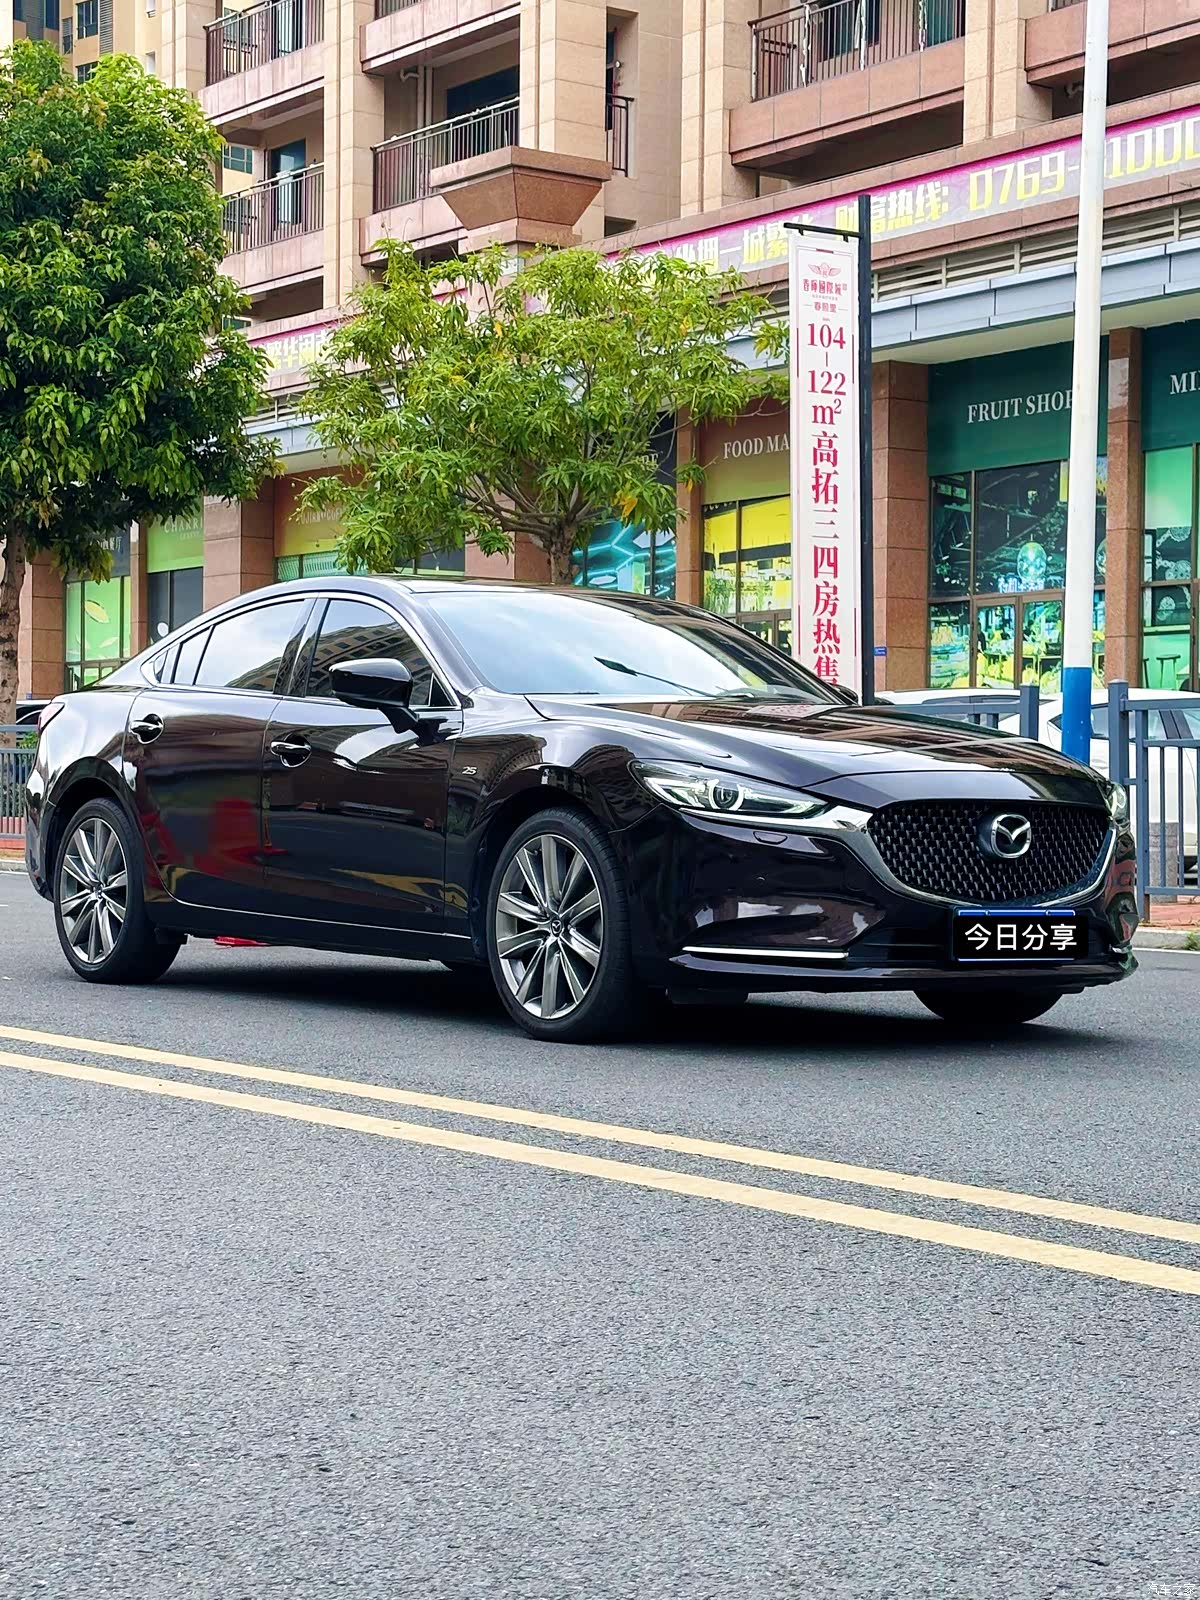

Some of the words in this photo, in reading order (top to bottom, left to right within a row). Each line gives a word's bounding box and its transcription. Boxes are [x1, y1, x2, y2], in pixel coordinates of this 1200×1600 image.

[807, 322, 846, 349] 104
[807, 370, 847, 396] 122
[967, 397, 1022, 424] FRUIT
[723, 437, 763, 459] FOOD
[462, 766, 477, 775] 25
